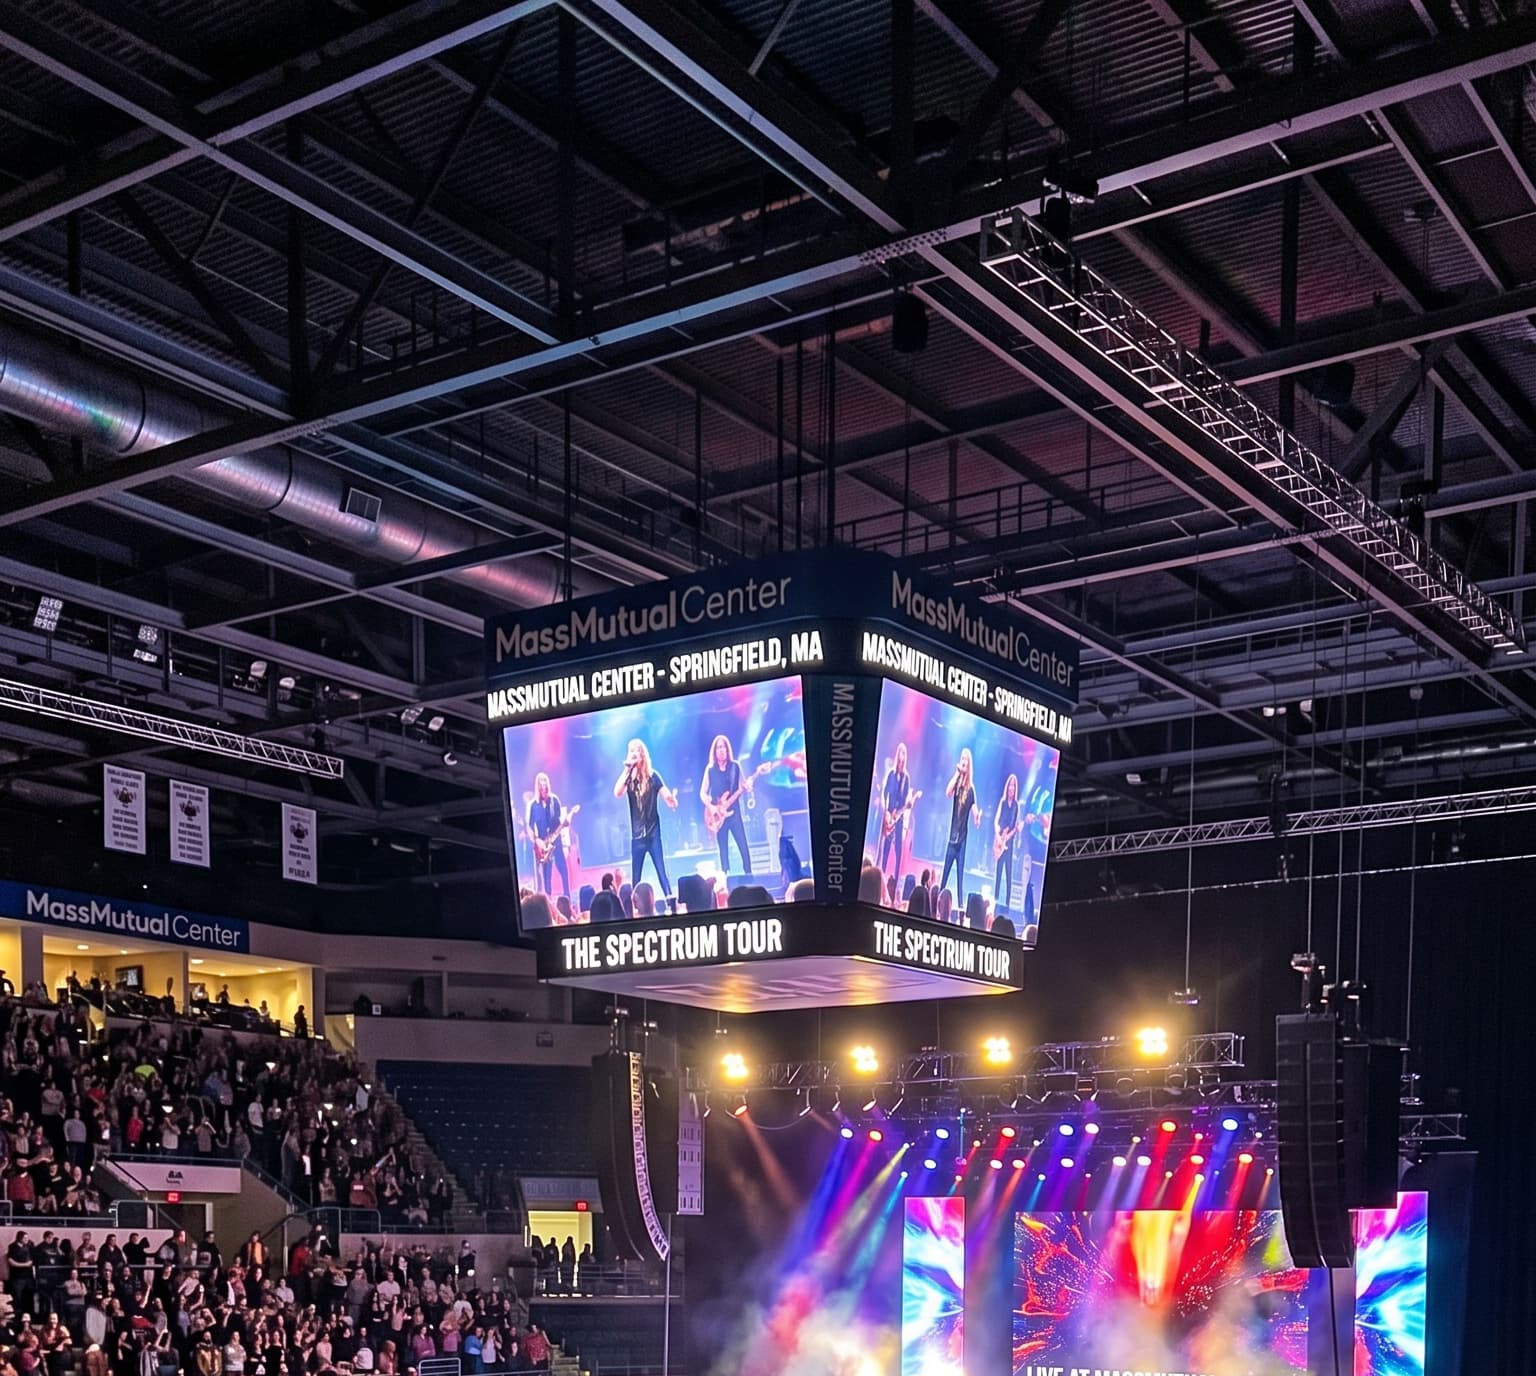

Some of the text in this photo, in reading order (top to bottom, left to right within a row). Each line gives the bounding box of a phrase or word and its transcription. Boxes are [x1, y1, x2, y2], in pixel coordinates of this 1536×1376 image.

[496, 576, 792, 663] MassMutual Center
[891, 570, 1074, 688] MassMutual Center
[591, 662, 655, 698] CENTER
[669, 637, 787, 684] SPRINGFIELD,
[791, 630, 823, 663] MA
[862, 631, 946, 689] MASSMUTUAL
[947, 665, 988, 707] CENTER
[994, 685, 1058, 741] SPRINGFIELD,
[1058, 714, 1073, 744] MA
[827, 682, 855, 893] MASSMUTUAL Center
[26, 889, 240, 946] MassMutual Center
[561, 918, 783, 969] THE SPECTRUM TOUR
[873, 920, 1010, 980] THE SPECTRUM TOUR
